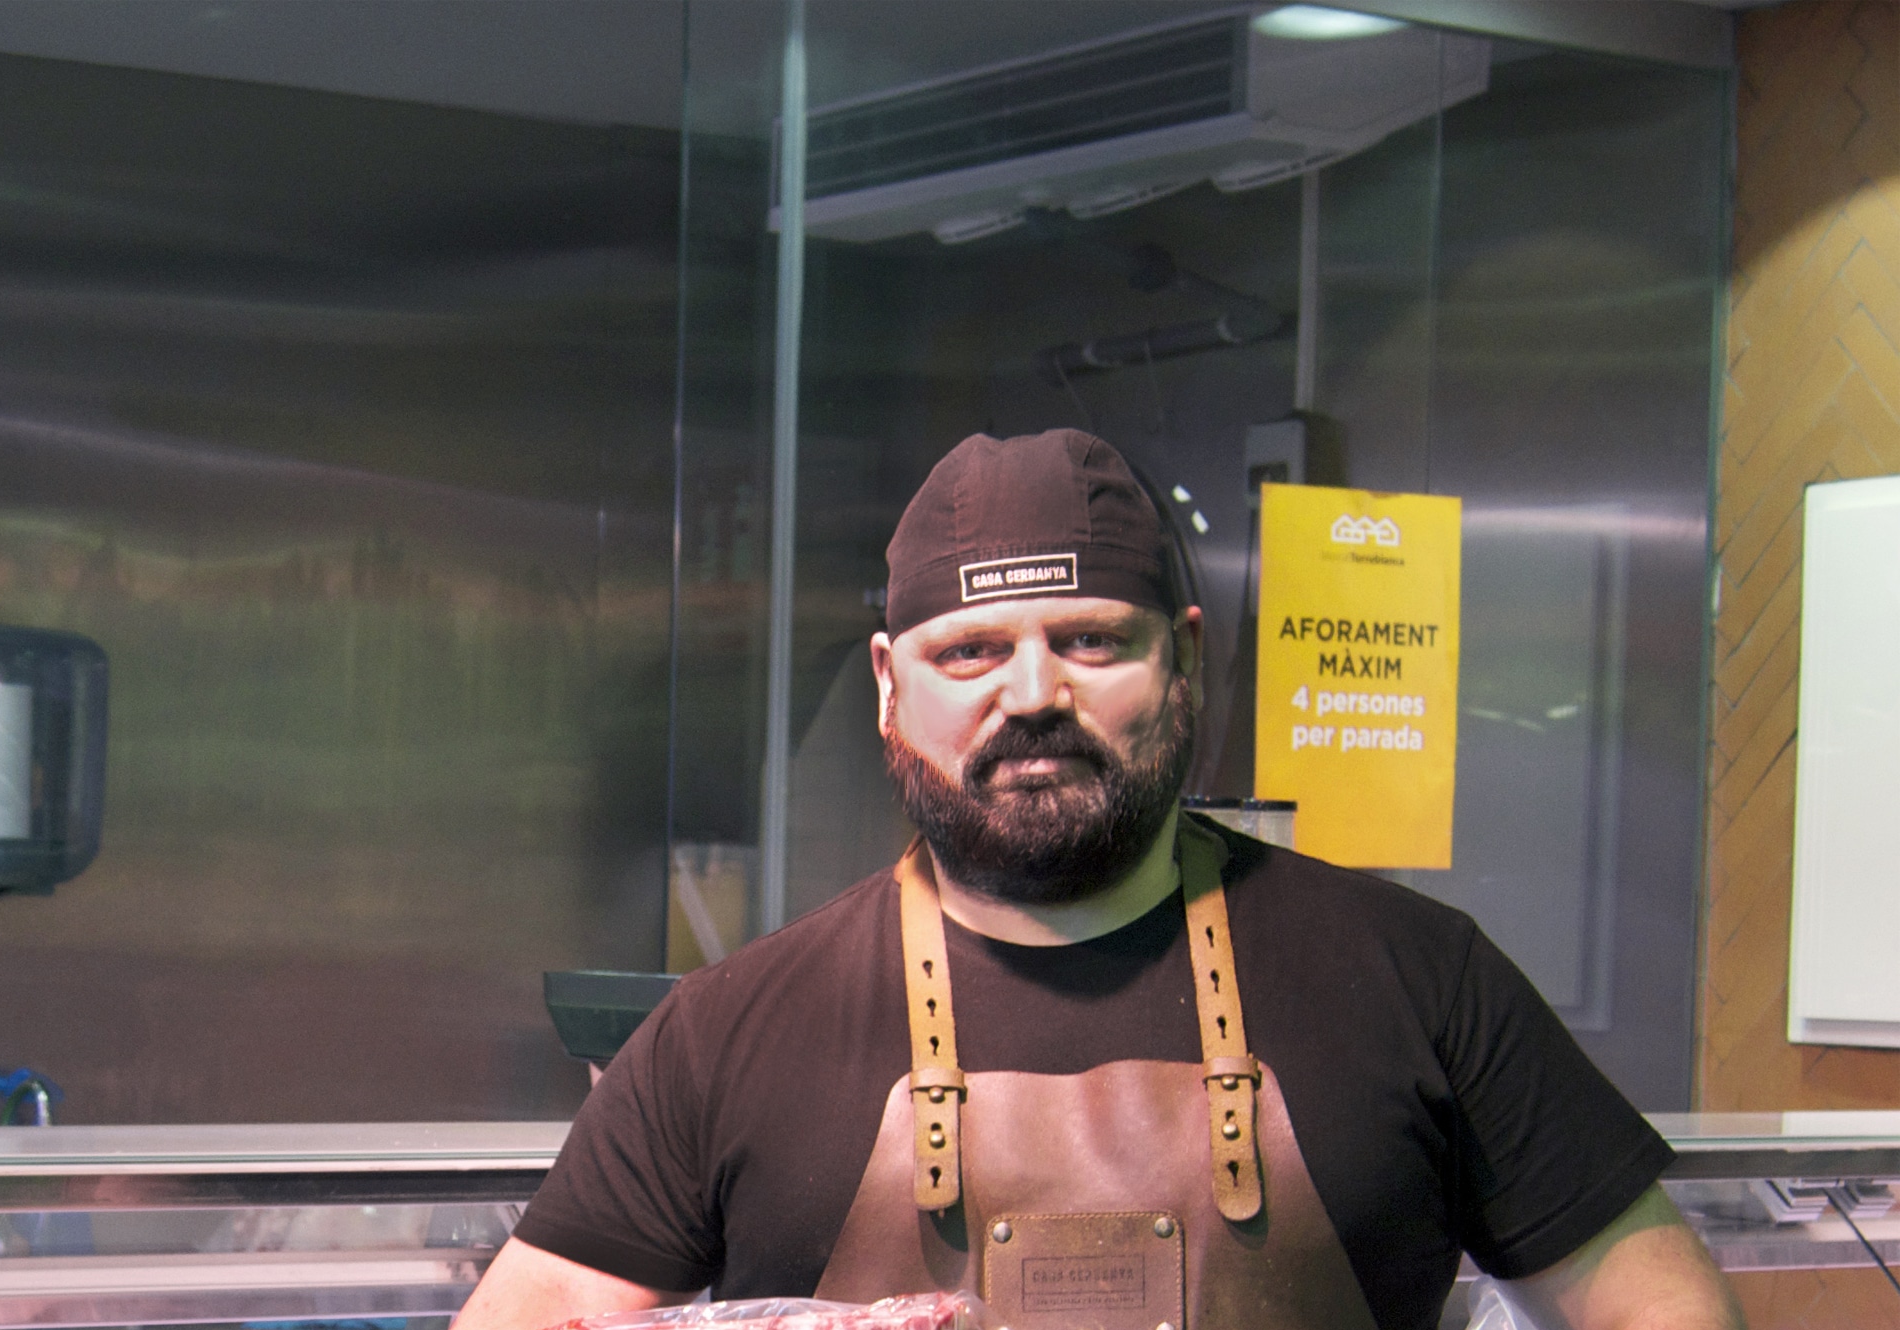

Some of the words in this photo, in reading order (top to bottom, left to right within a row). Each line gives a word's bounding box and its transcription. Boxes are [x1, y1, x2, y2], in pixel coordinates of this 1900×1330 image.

[971, 571, 1003, 589] CASA
[1005, 566, 1068, 584] CERDANYA
[1279, 616, 1439, 648] AFORAMENT
[1318, 648, 1402, 680] MÀXIM
[1291, 683, 1310, 711] 4
[1316, 690, 1427, 718] persones
[1292, 724, 1336, 751] per
[1341, 724, 1425, 752] parada
